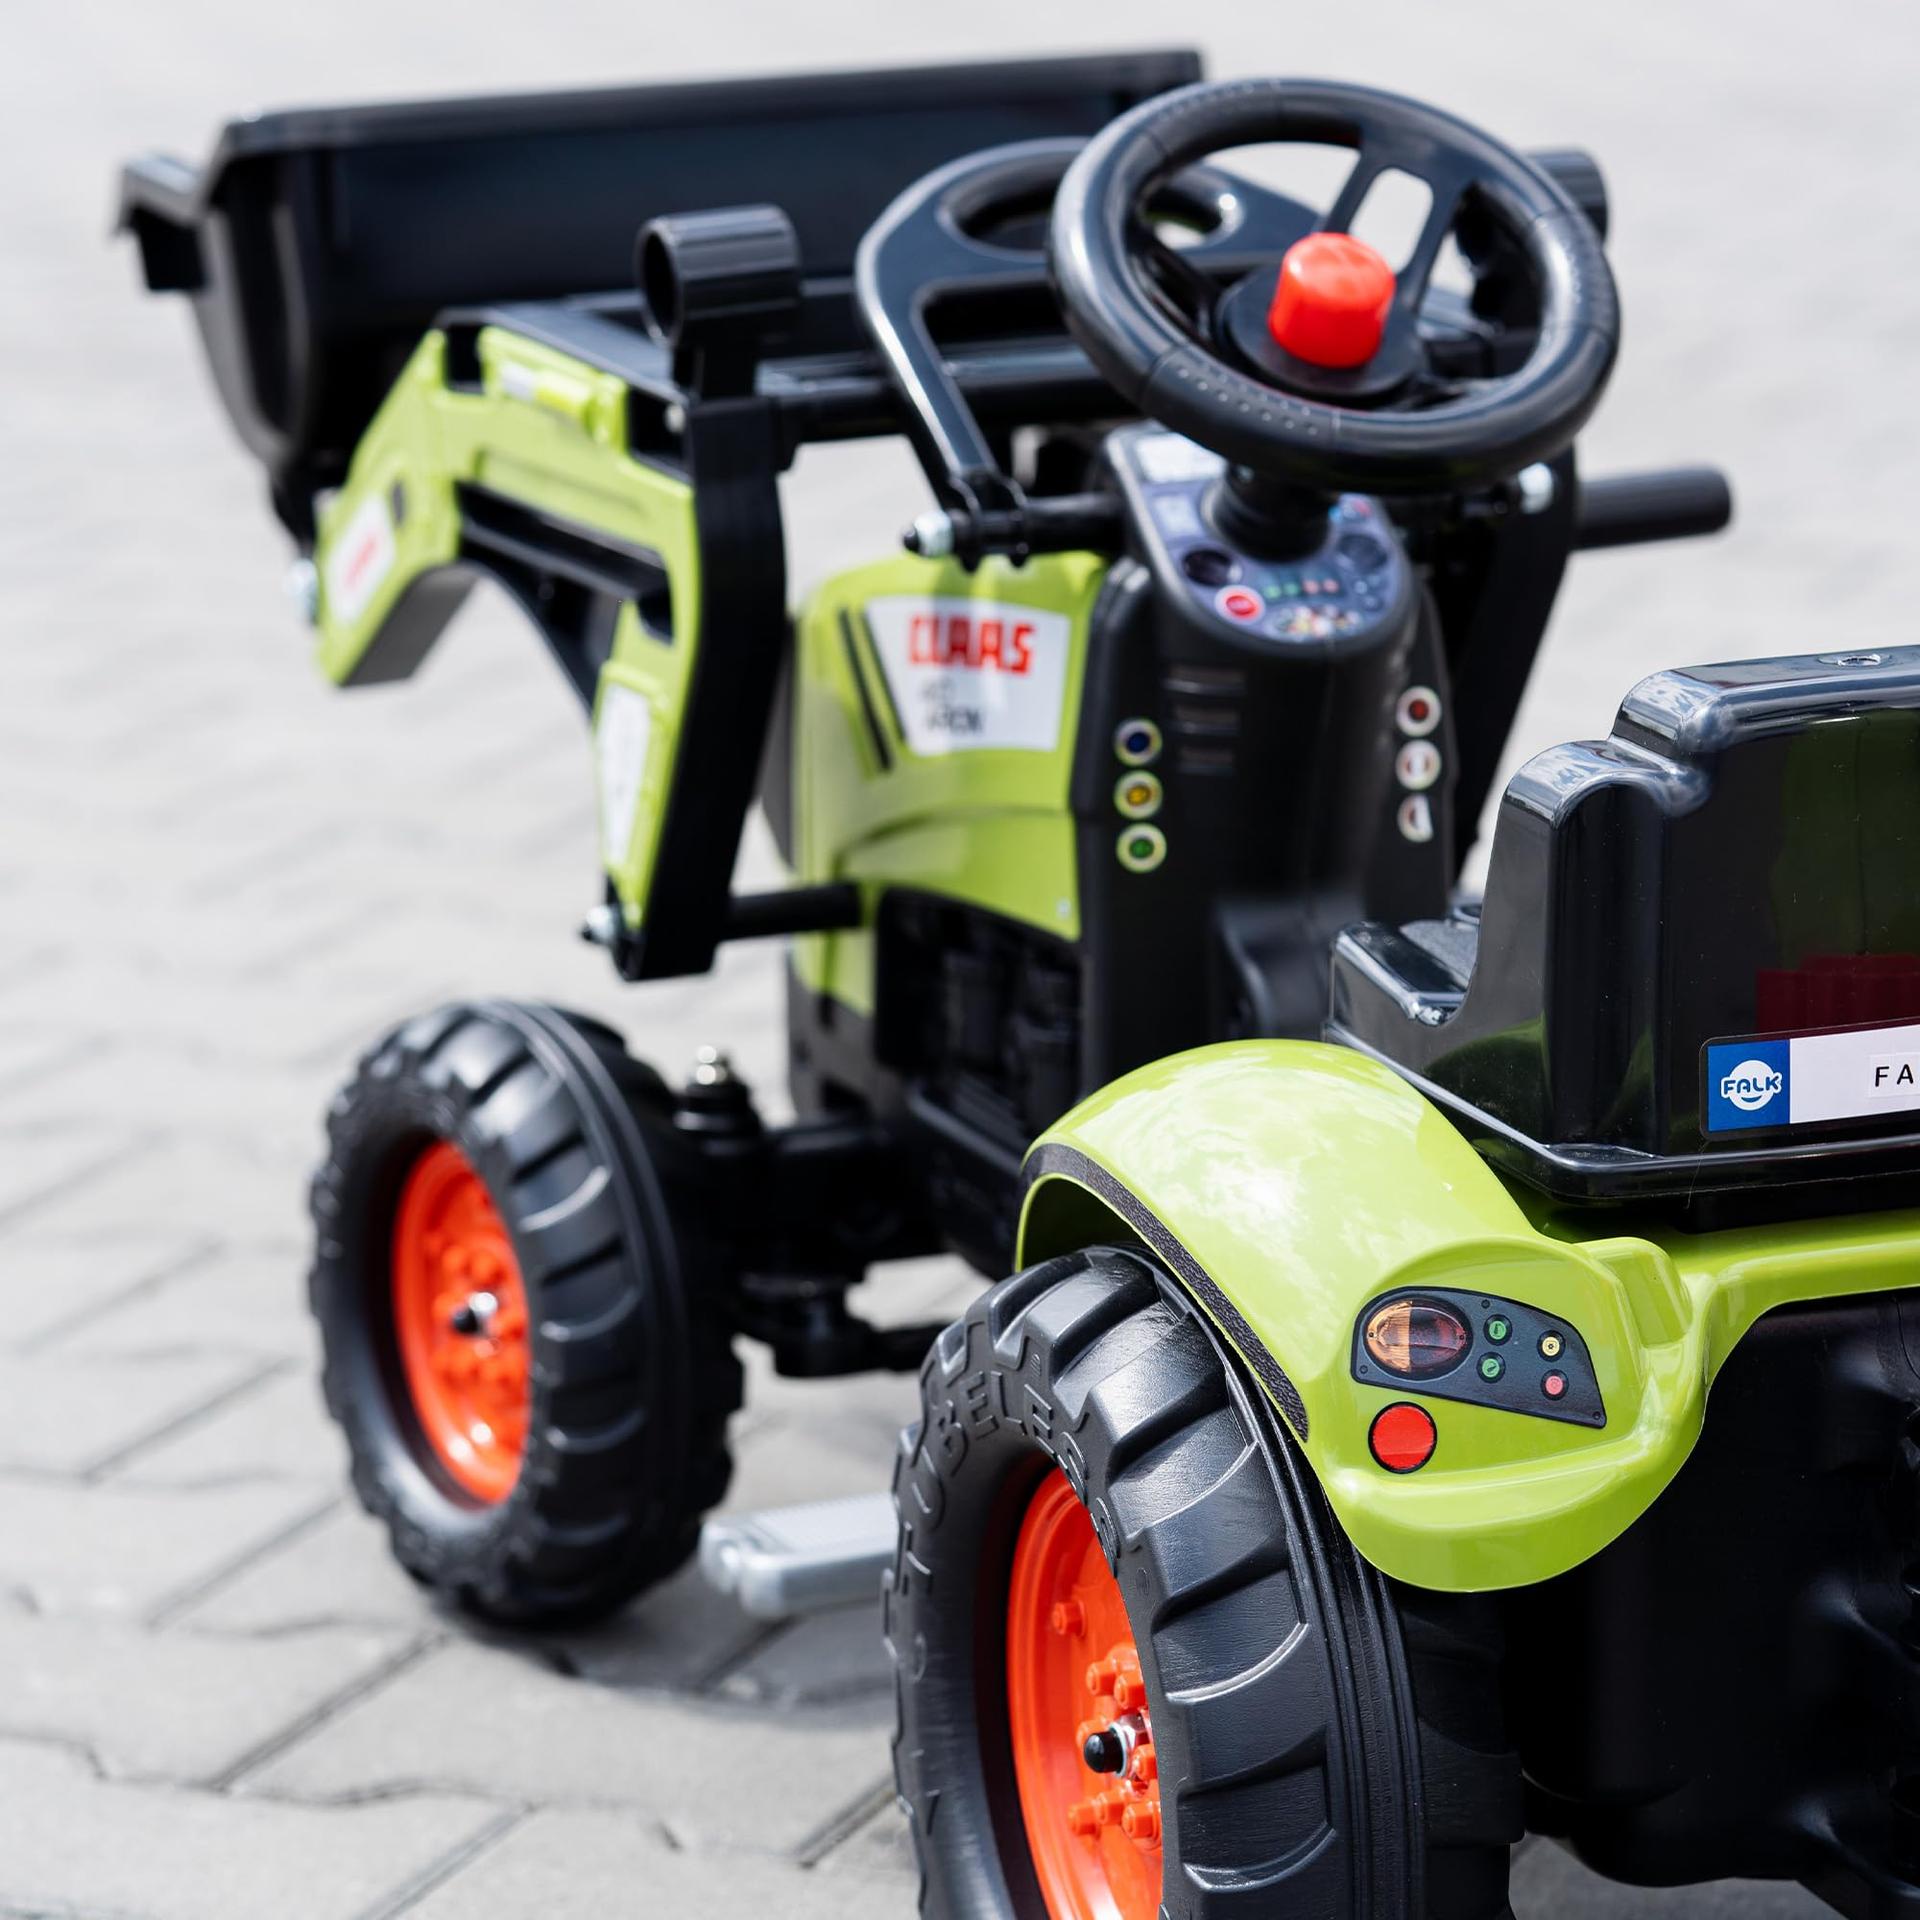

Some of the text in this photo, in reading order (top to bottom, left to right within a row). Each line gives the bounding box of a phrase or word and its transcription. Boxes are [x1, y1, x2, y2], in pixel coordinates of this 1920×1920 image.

[909, 615, 1034, 675] CLAAS
[1723, 1075, 1780, 1095] FALK
[1875, 1063, 1914, 1087] FA
